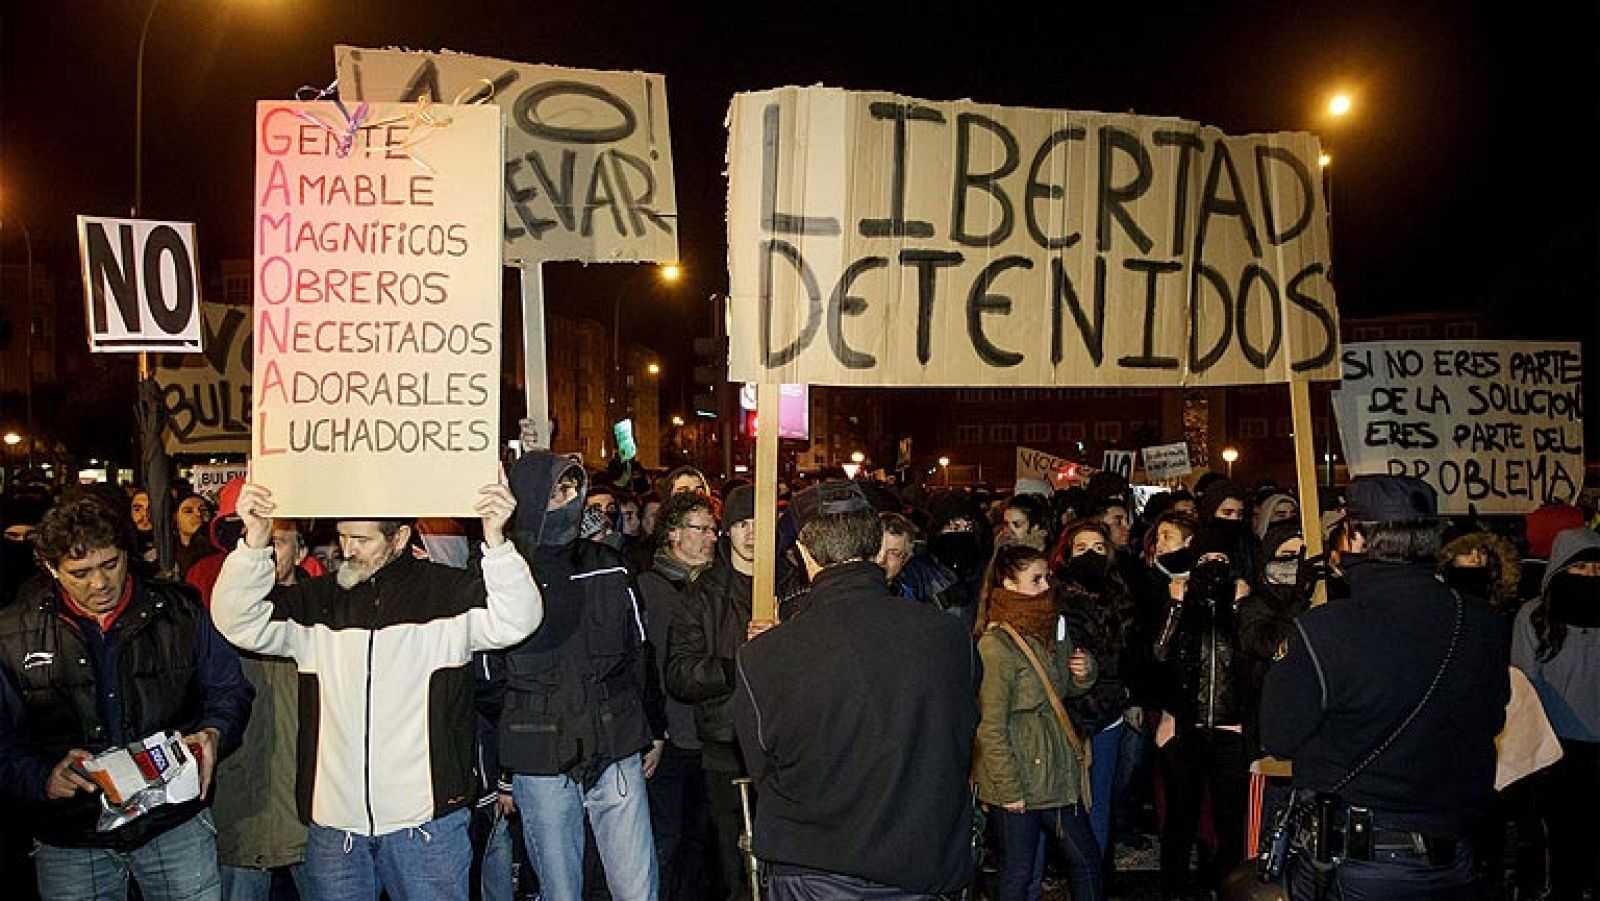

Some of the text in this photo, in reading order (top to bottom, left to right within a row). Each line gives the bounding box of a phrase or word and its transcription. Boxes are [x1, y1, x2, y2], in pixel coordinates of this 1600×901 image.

[262, 160, 434, 207] AMABLE
[505, 150, 673, 241] EVAR
[760, 101, 1314, 258] LIBERTAD
[86, 222, 194, 334] NO
[260, 256, 449, 306] OBREROS
[759, 239, 1338, 372] DETENIDOS
[258, 360, 488, 407] ADORABLES
[1342, 350, 1583, 385] SI NO ERES PARTE
[1368, 387, 1408, 415] DE
[1416, 385, 1451, 414] LA
[260, 411, 490, 456] LUCHADORES
[1364, 420, 1582, 454] ERES PARTE DEL
